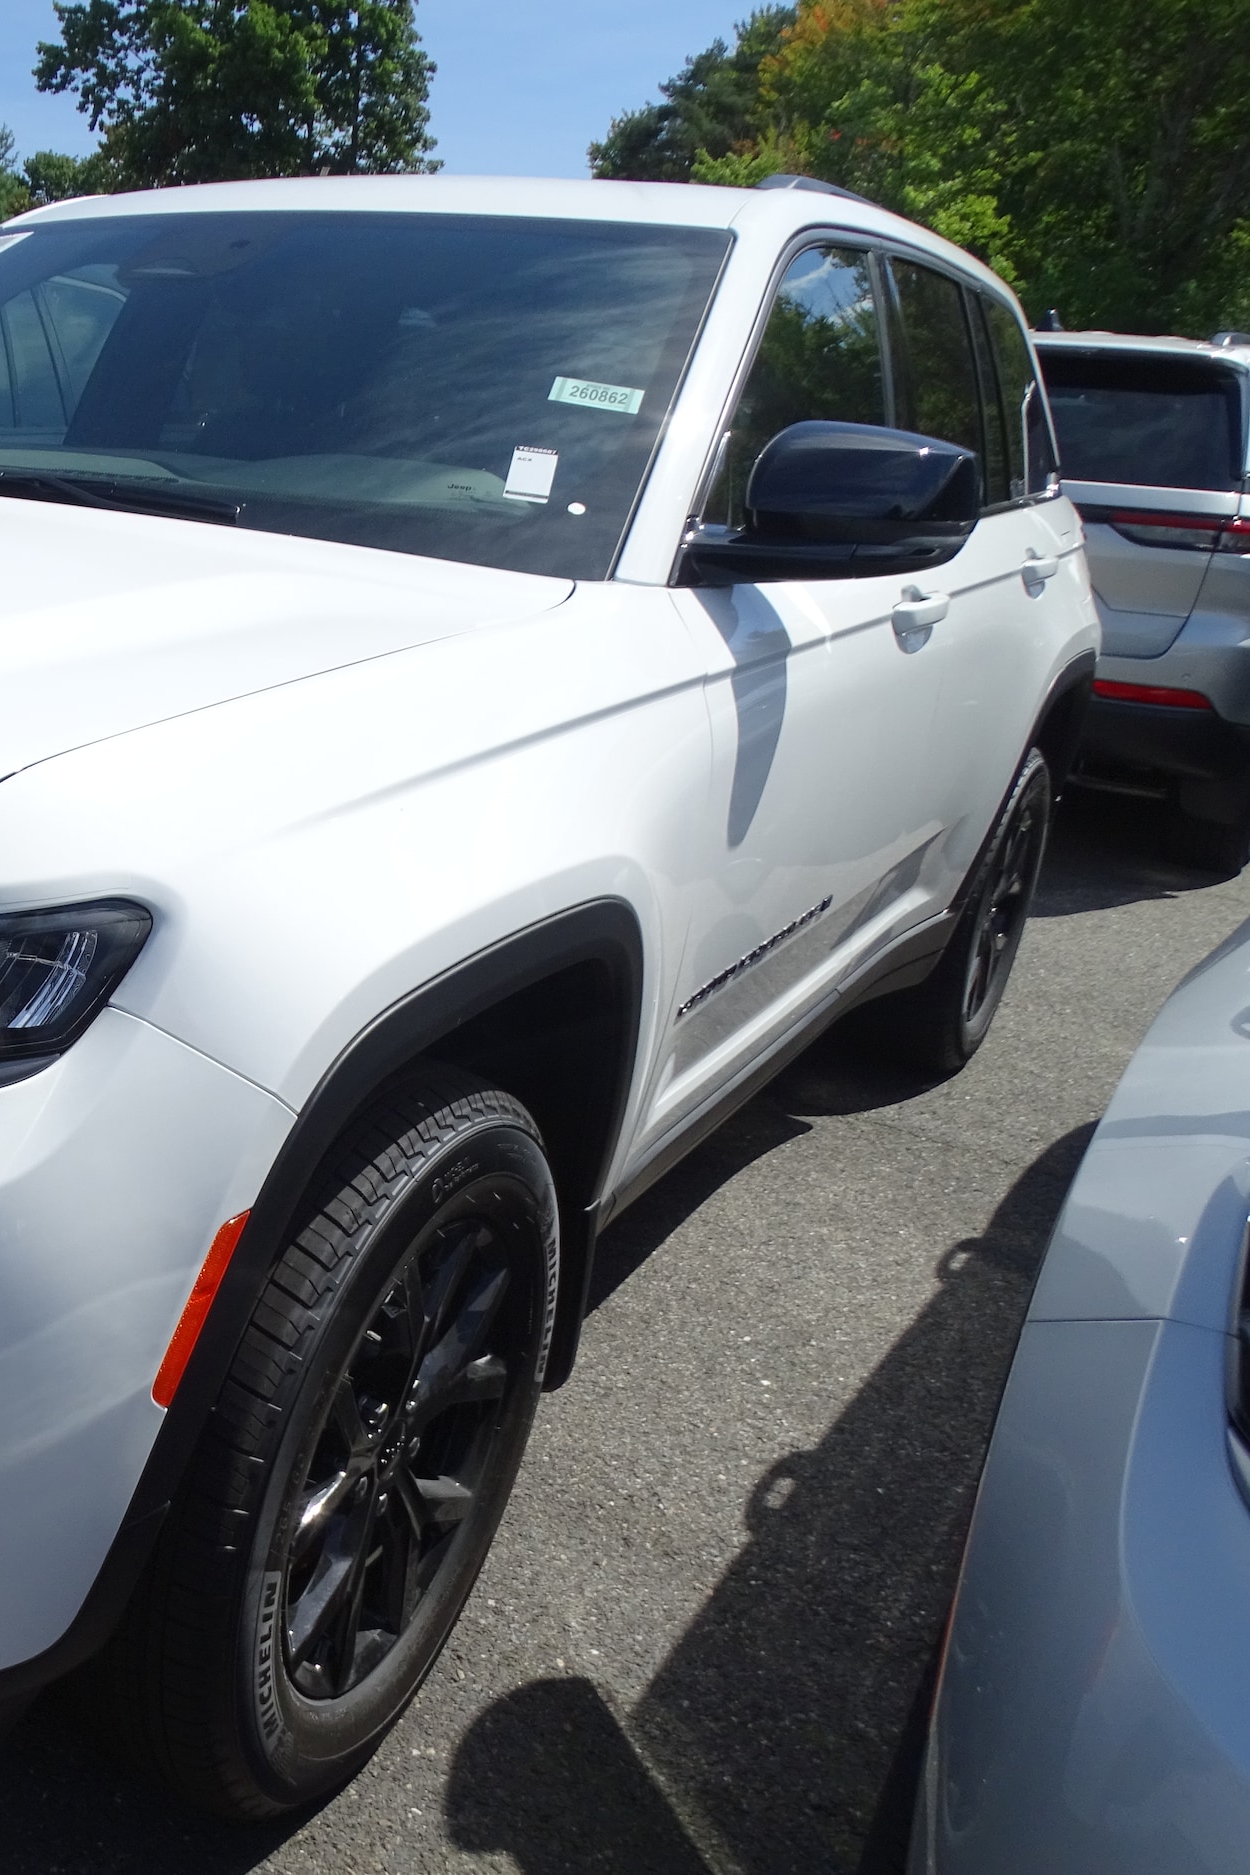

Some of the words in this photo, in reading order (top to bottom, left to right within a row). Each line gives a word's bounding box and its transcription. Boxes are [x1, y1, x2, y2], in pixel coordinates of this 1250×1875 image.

[568, 385, 629, 405] 260862
[537, 1236, 558, 1375] MICHELIN
[257, 1581, 281, 1742] MICHELIN
